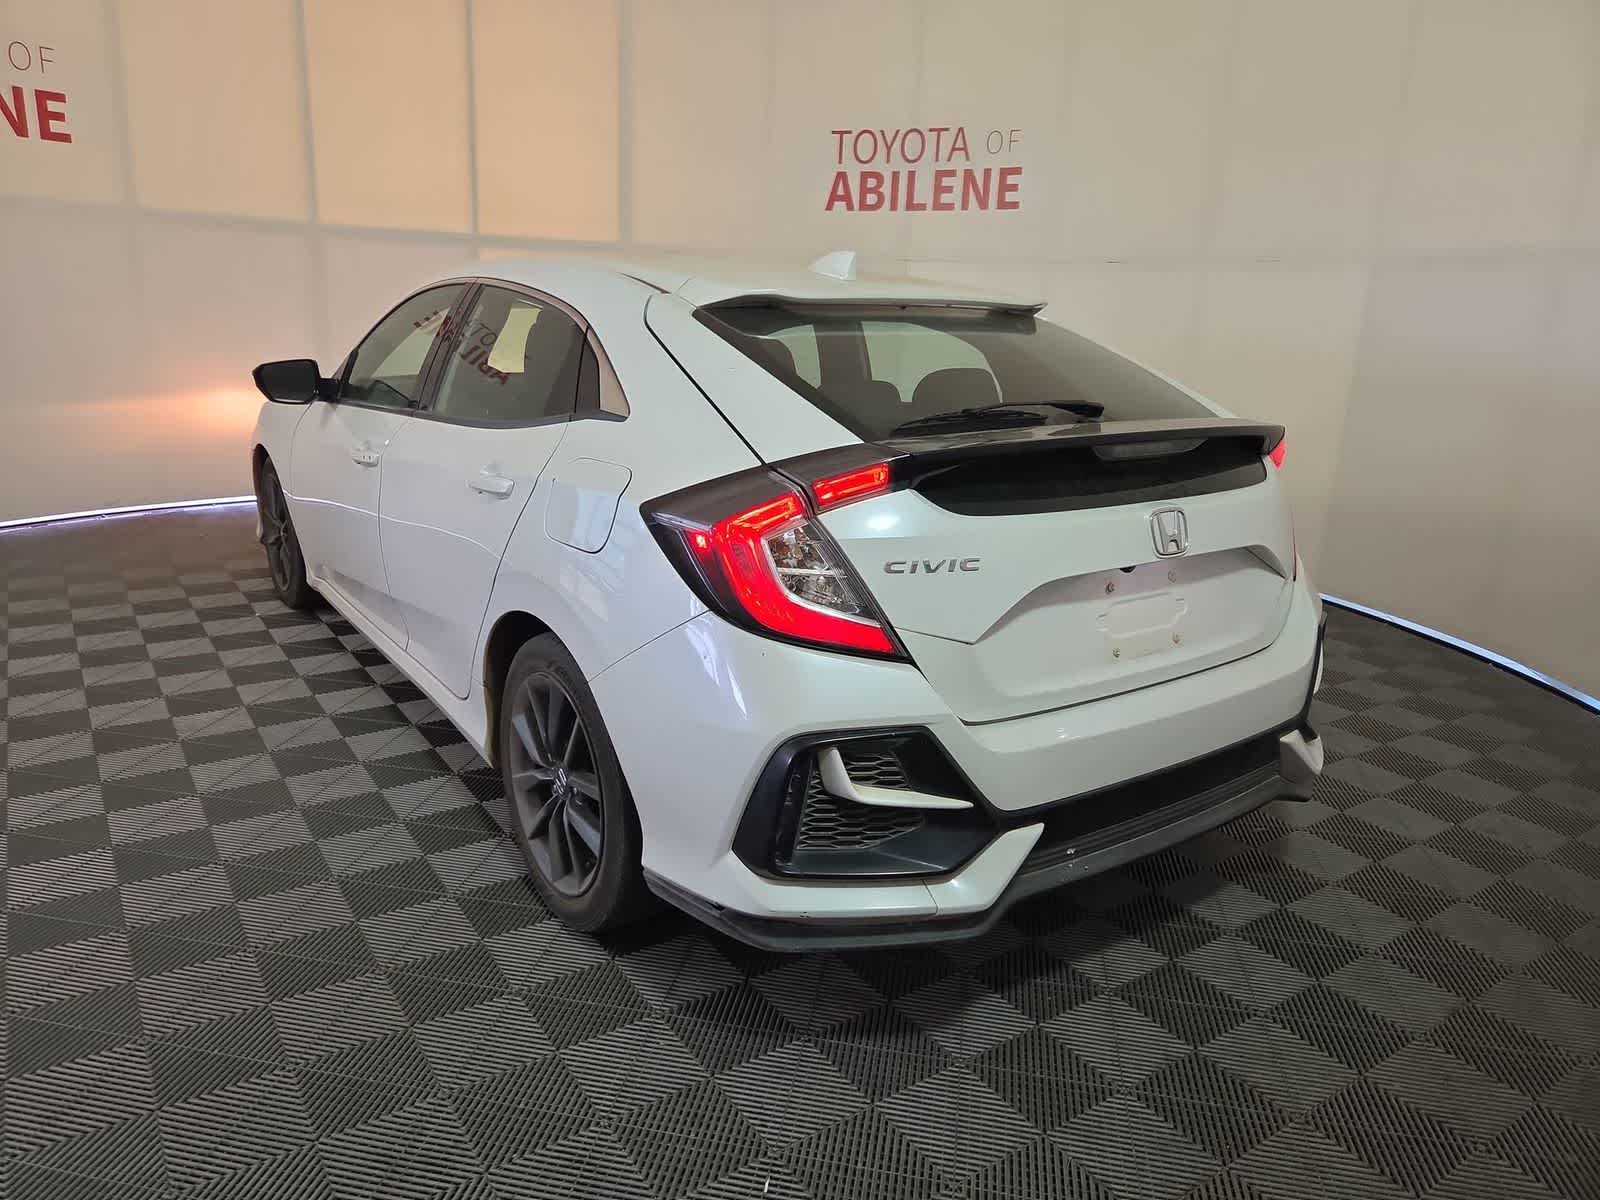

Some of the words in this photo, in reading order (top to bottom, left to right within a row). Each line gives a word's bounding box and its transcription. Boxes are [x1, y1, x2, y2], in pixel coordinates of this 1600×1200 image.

[8, 41, 56, 74] OF
[831, 126, 971, 165] TOYOTA
[986, 128, 1024, 155] OF
[824, 166, 1023, 212] ABILENE
[883, 557, 981, 574] CIVIC
